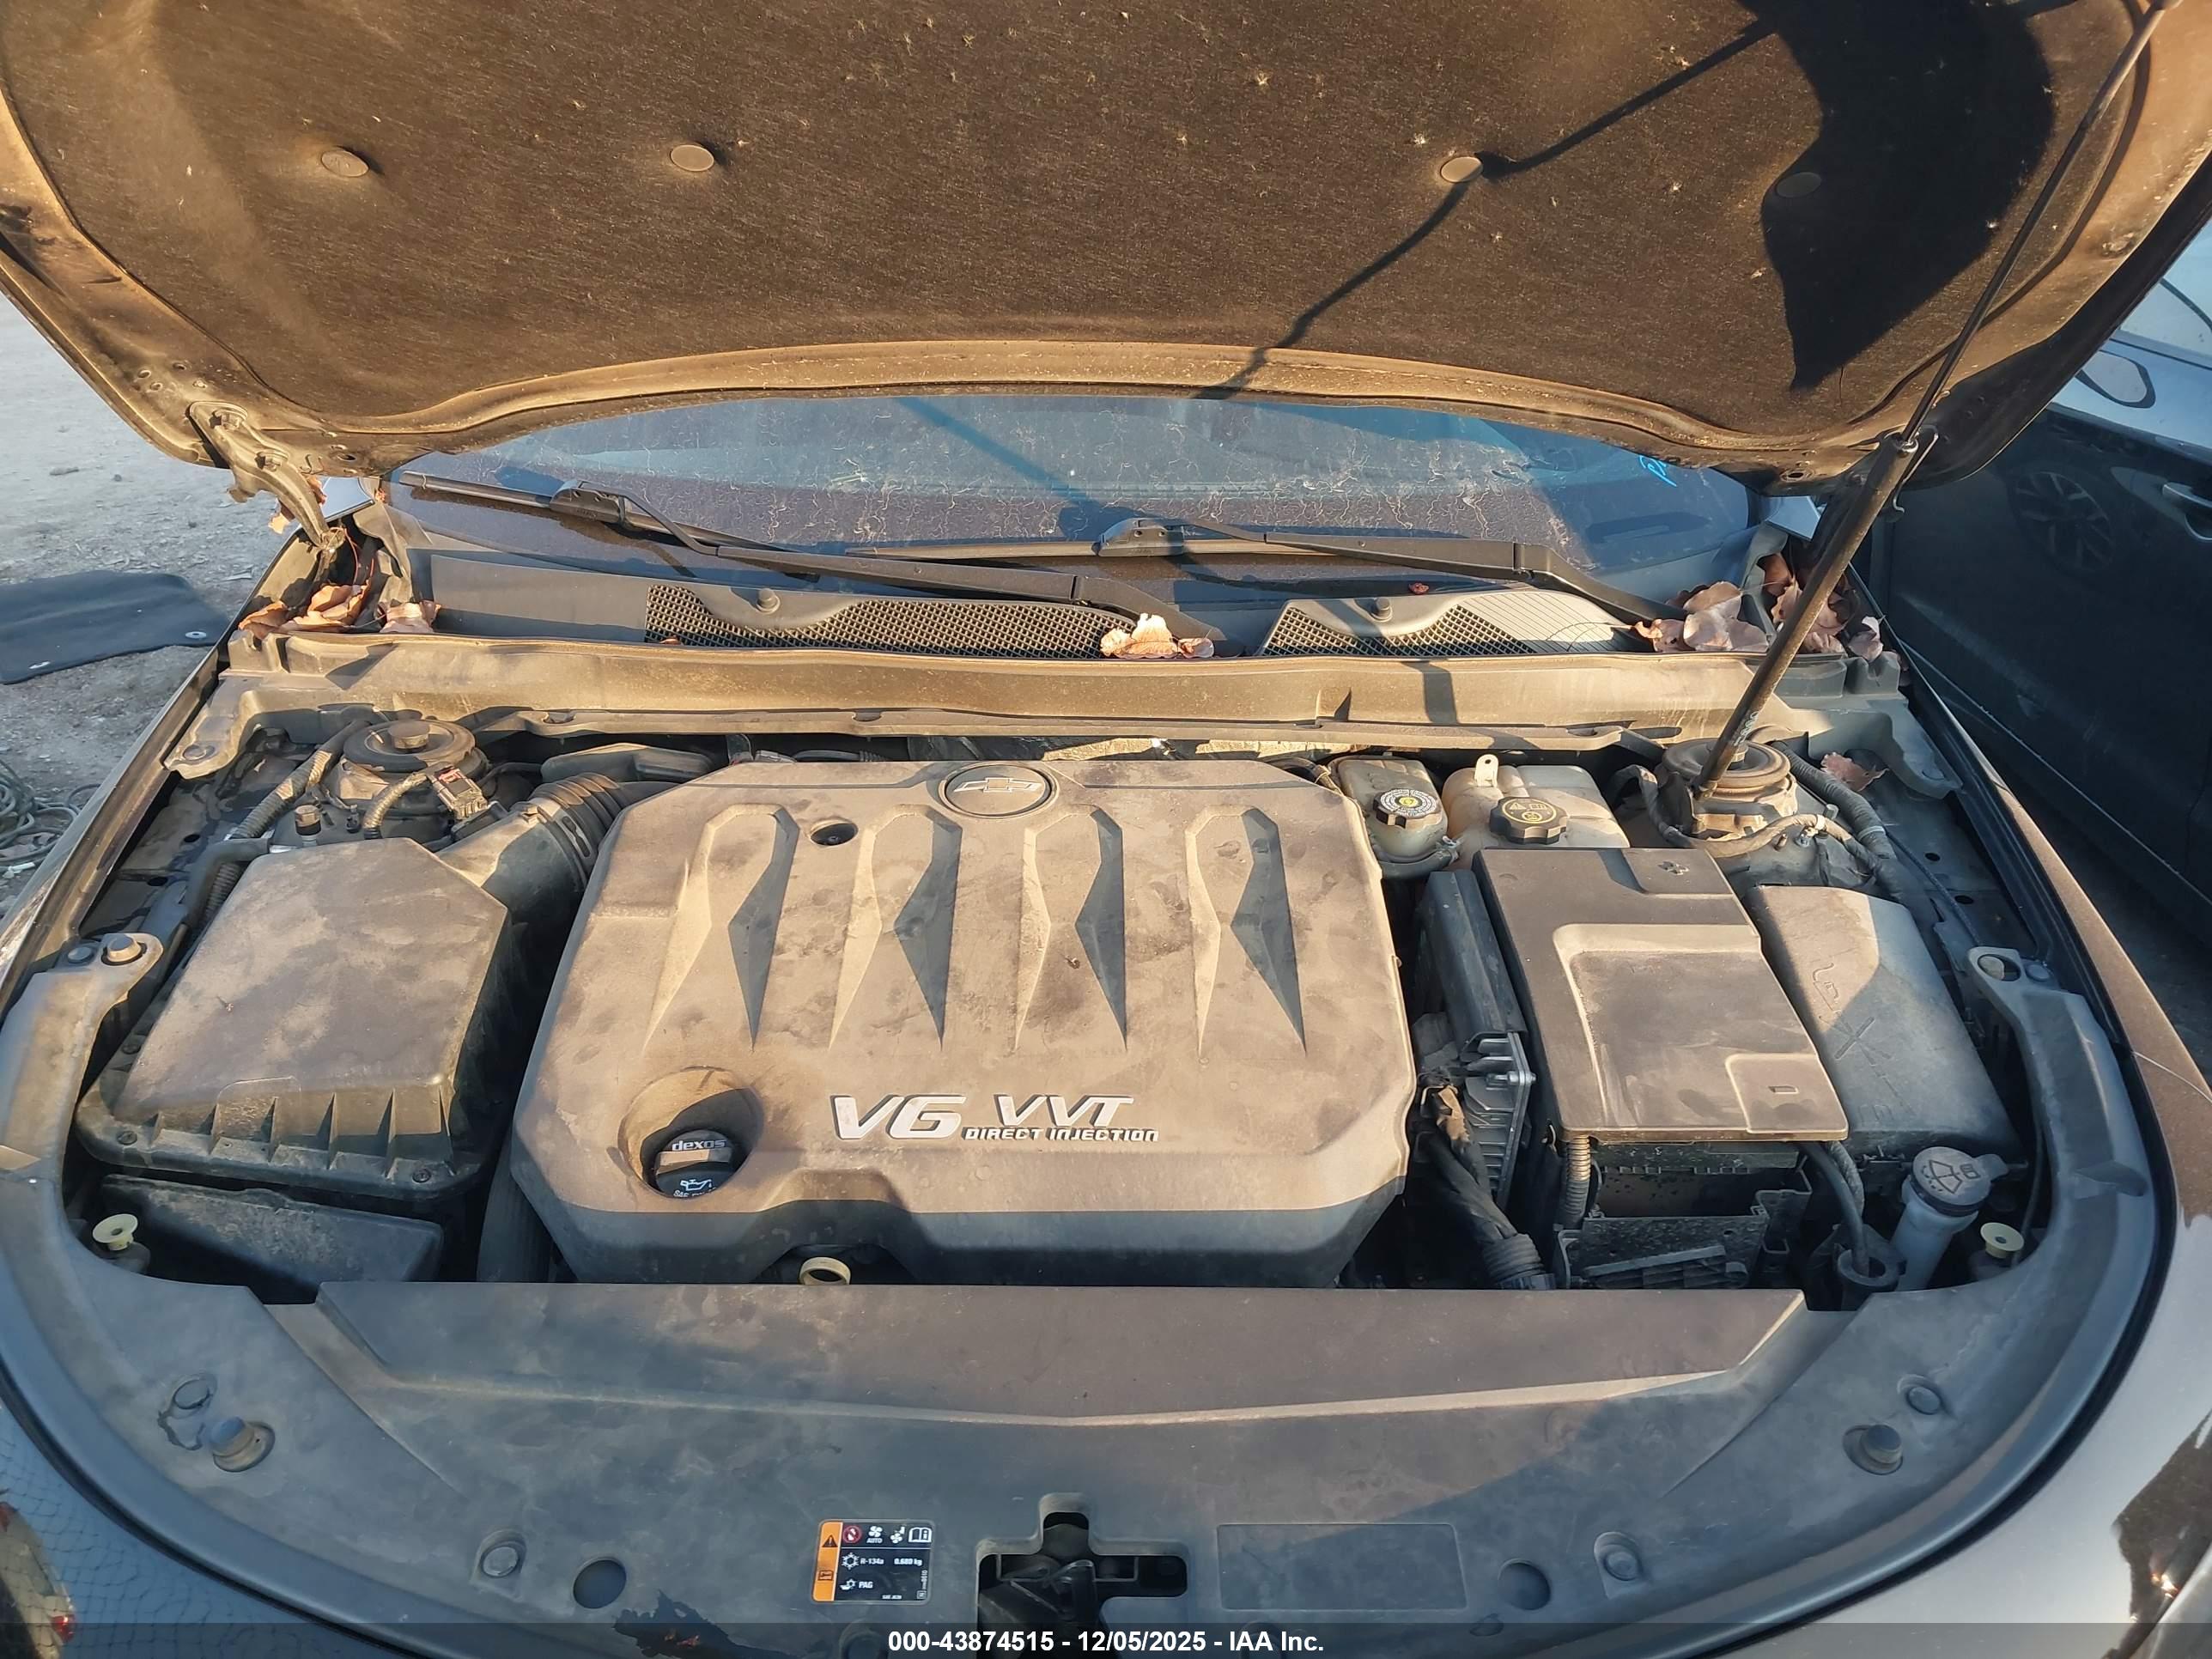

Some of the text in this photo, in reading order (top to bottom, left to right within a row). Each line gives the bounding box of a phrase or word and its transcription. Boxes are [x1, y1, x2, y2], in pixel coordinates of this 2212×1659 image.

[831, 1094, 1134, 1139] V6 VVT
[962, 1127, 1159, 1142] DIRECT INJECTION
[672, 1139, 726, 1151] dexos
